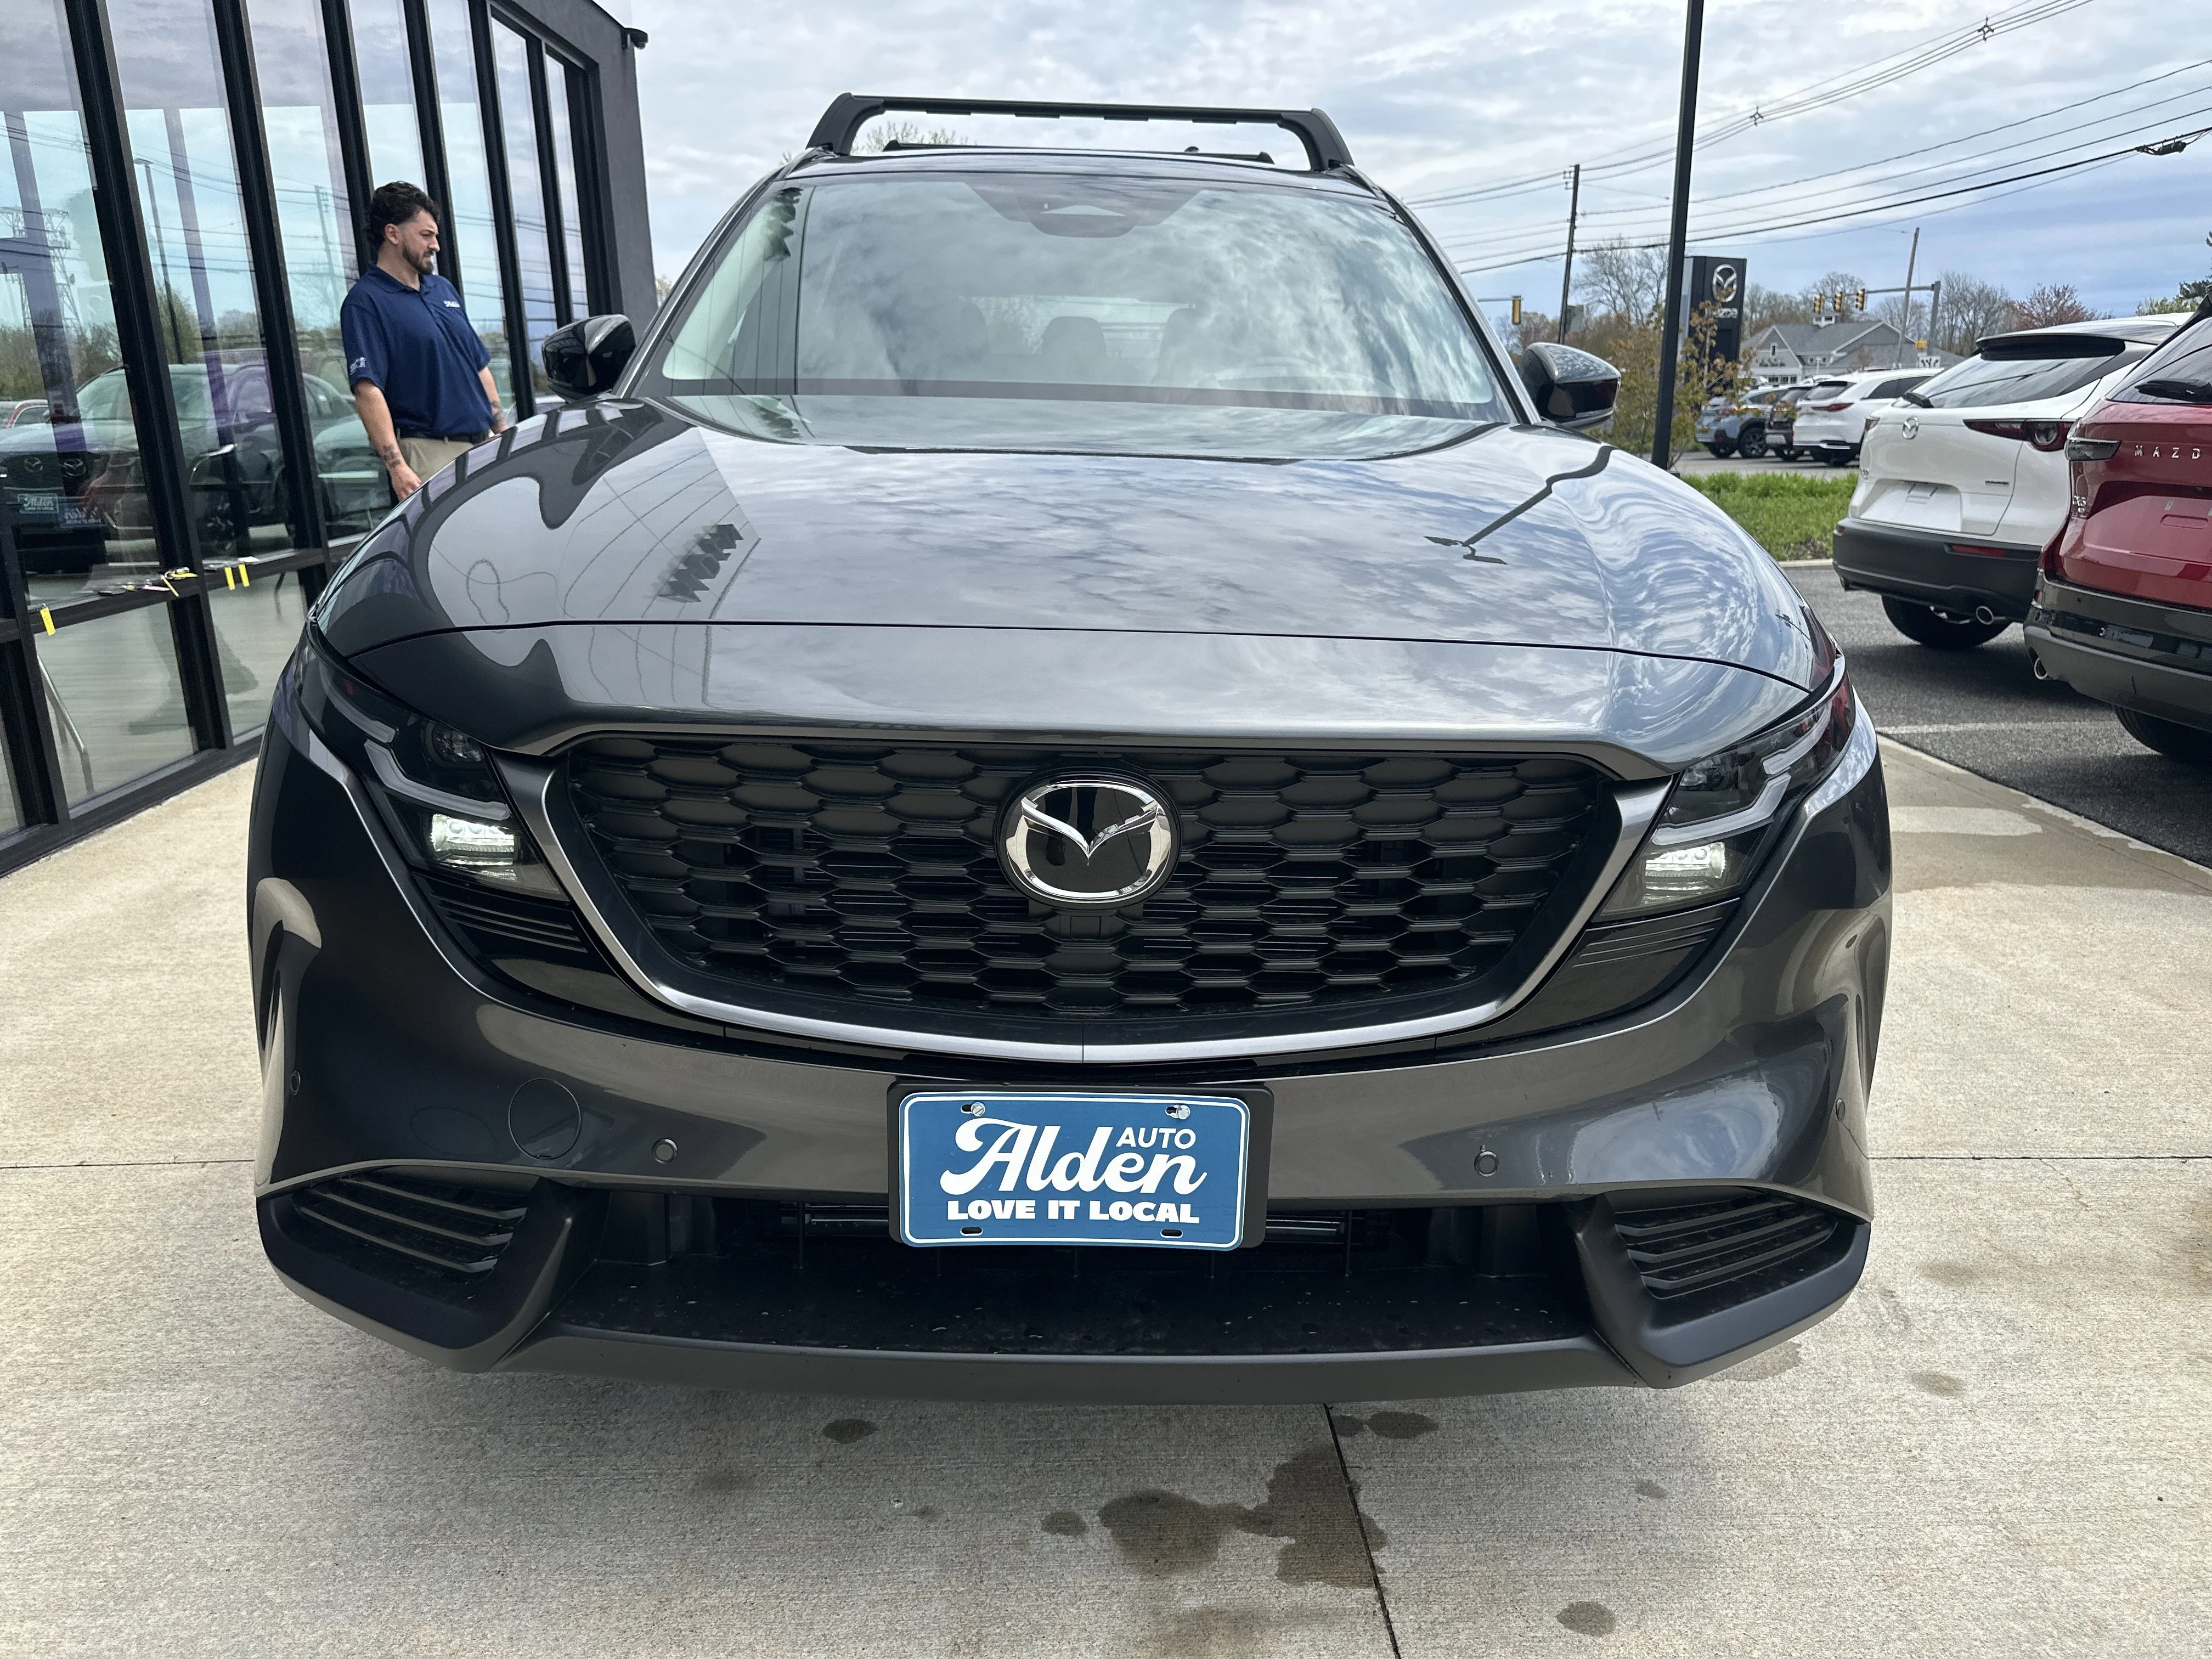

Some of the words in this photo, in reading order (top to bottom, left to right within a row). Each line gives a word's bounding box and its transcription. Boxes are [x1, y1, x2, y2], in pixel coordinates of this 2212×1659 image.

[2134, 445, 2201, 460] MAZD
[1115, 1127, 1197, 1149] AUTO
[940, 1118, 1207, 1195] Alden
[947, 1199, 1036, 1220] LOVE
[1048, 1200, 1080, 1220] IT
[1089, 1200, 1200, 1223] LOCAL
